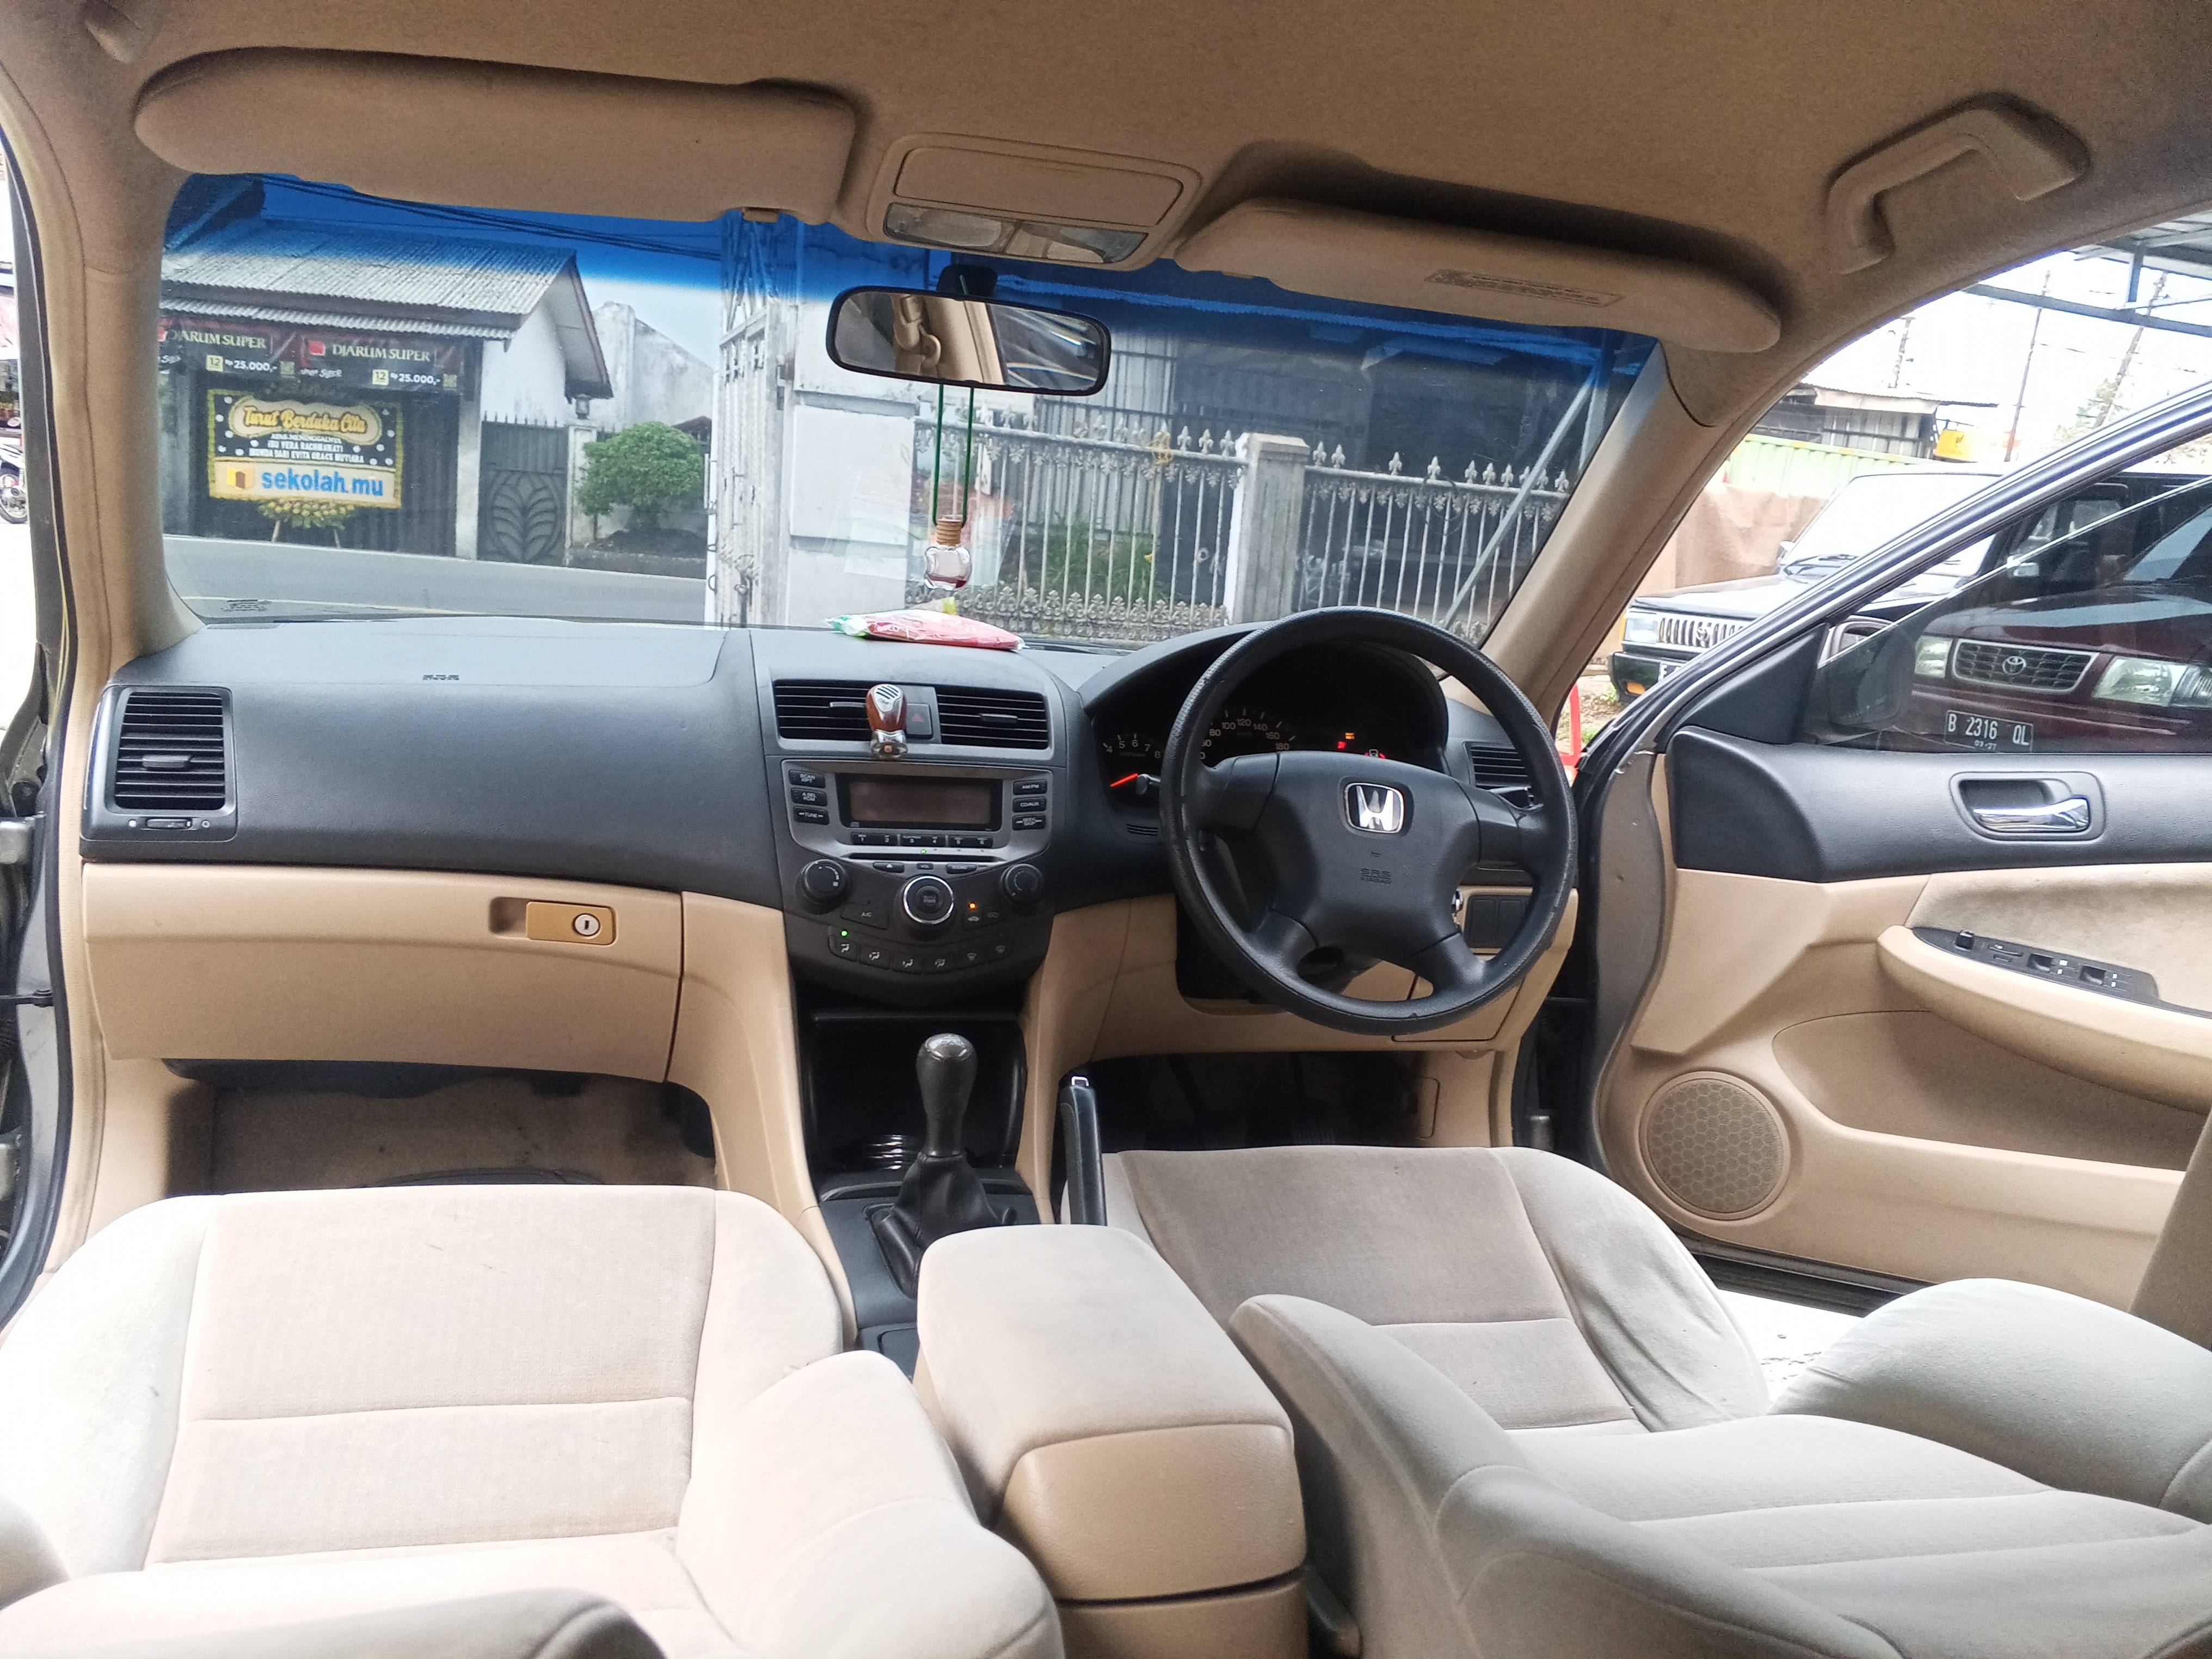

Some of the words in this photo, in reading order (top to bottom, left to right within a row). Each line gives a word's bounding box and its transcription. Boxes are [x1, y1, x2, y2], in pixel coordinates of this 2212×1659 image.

[222, 334, 267, 349] SUPER
[333, 343, 386, 359] DJARUM
[389, 348, 431, 361] SUPER
[375, 371, 386, 380] 12
[1222, 722, 1236, 730] 100
[1237, 718, 1251, 727] 120
[1253, 723, 1268, 732] 140
[1275, 742, 1289, 751] 180
[1948, 714, 1957, 732] B
[1965, 716, 1998, 740] 2316
[1144, 744, 1151, 752] 7
[1154, 751, 1161, 759] 8
[1361, 868, 1391, 877] SRS
